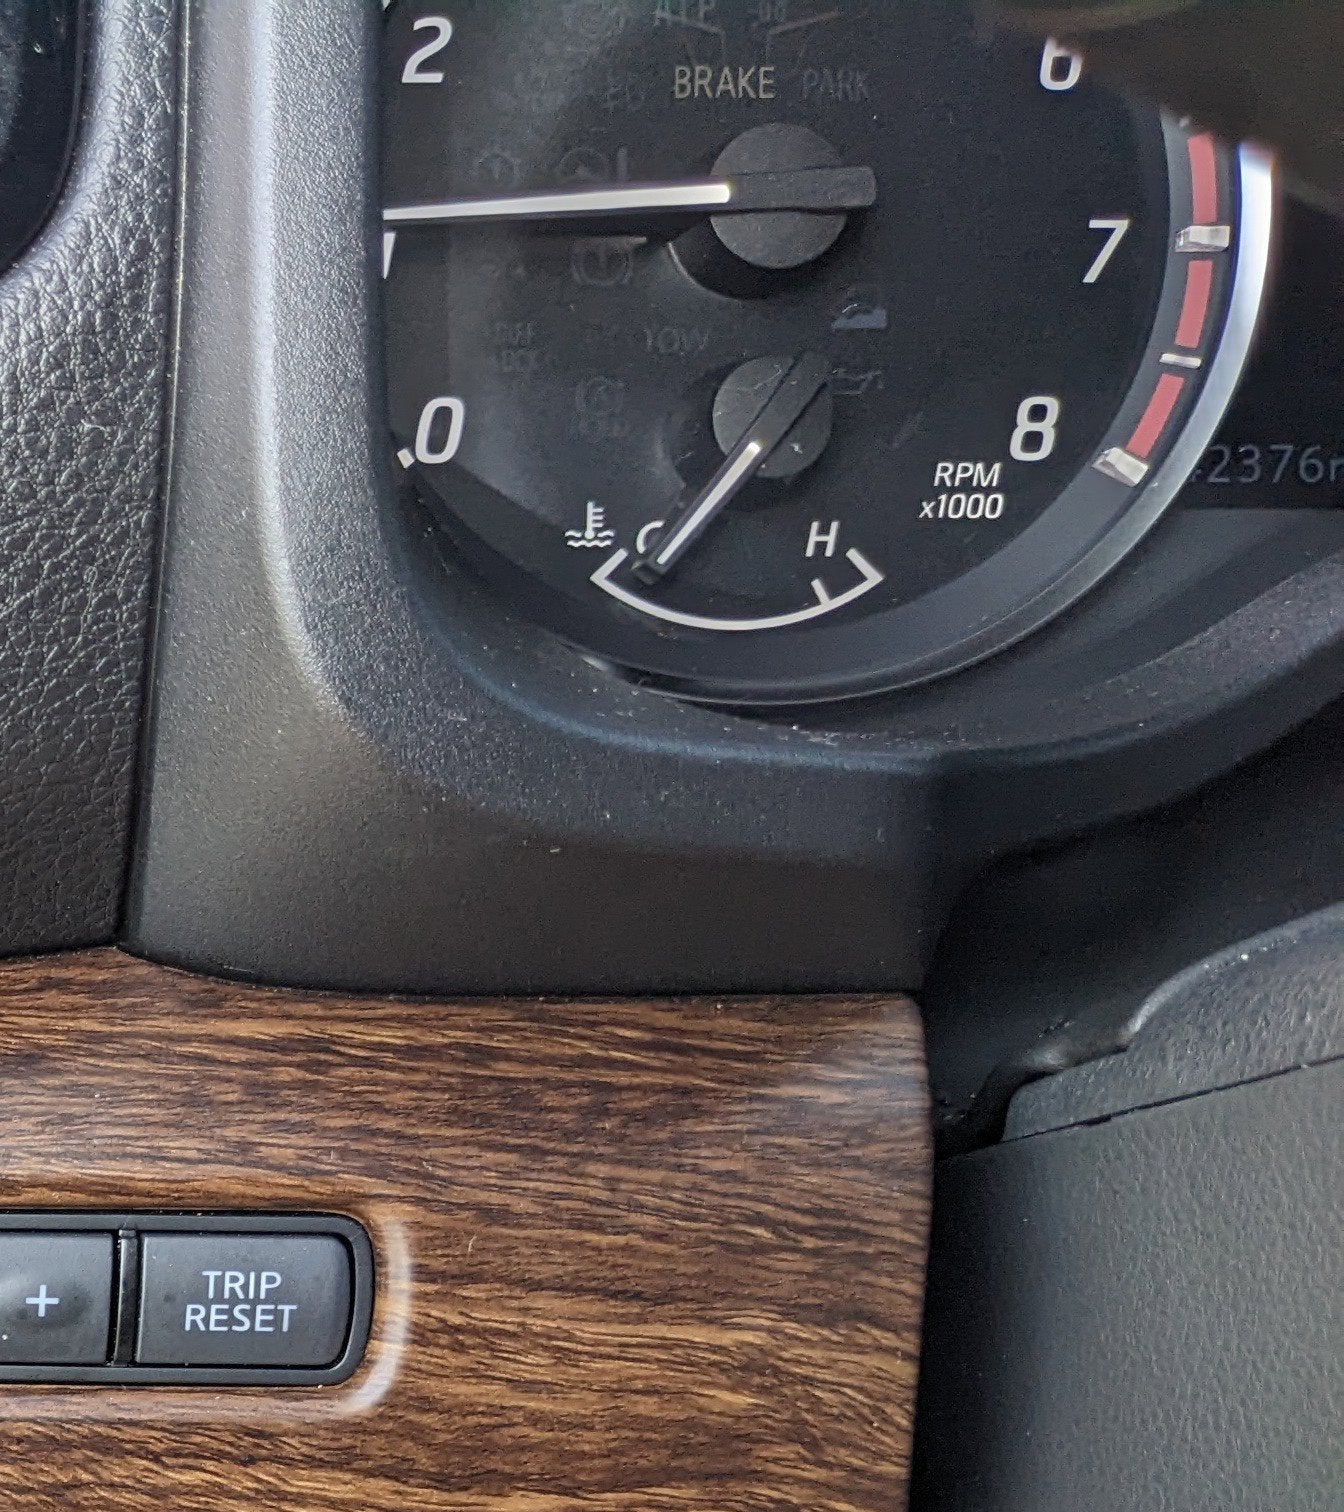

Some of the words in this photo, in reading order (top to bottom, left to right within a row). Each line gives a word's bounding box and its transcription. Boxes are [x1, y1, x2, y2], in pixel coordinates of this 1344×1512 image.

[401, 15, 453, 84] 2
[1039, 37, 1083, 91] 6
[673, 64, 776, 99] BRAKE
[1082, 218, 1130, 284] 7
[415, 396, 466, 464] 0
[1009, 395, 1060, 462] 8
[933, 461, 1002, 488] RPM
[1190, 442, 1344, 486] 2376
[918, 492, 1005, 520] x1000
[805, 520, 840, 558] H
[201, 1270, 282, 1299] TRIP
[184, 1303, 298, 1332] RESET
